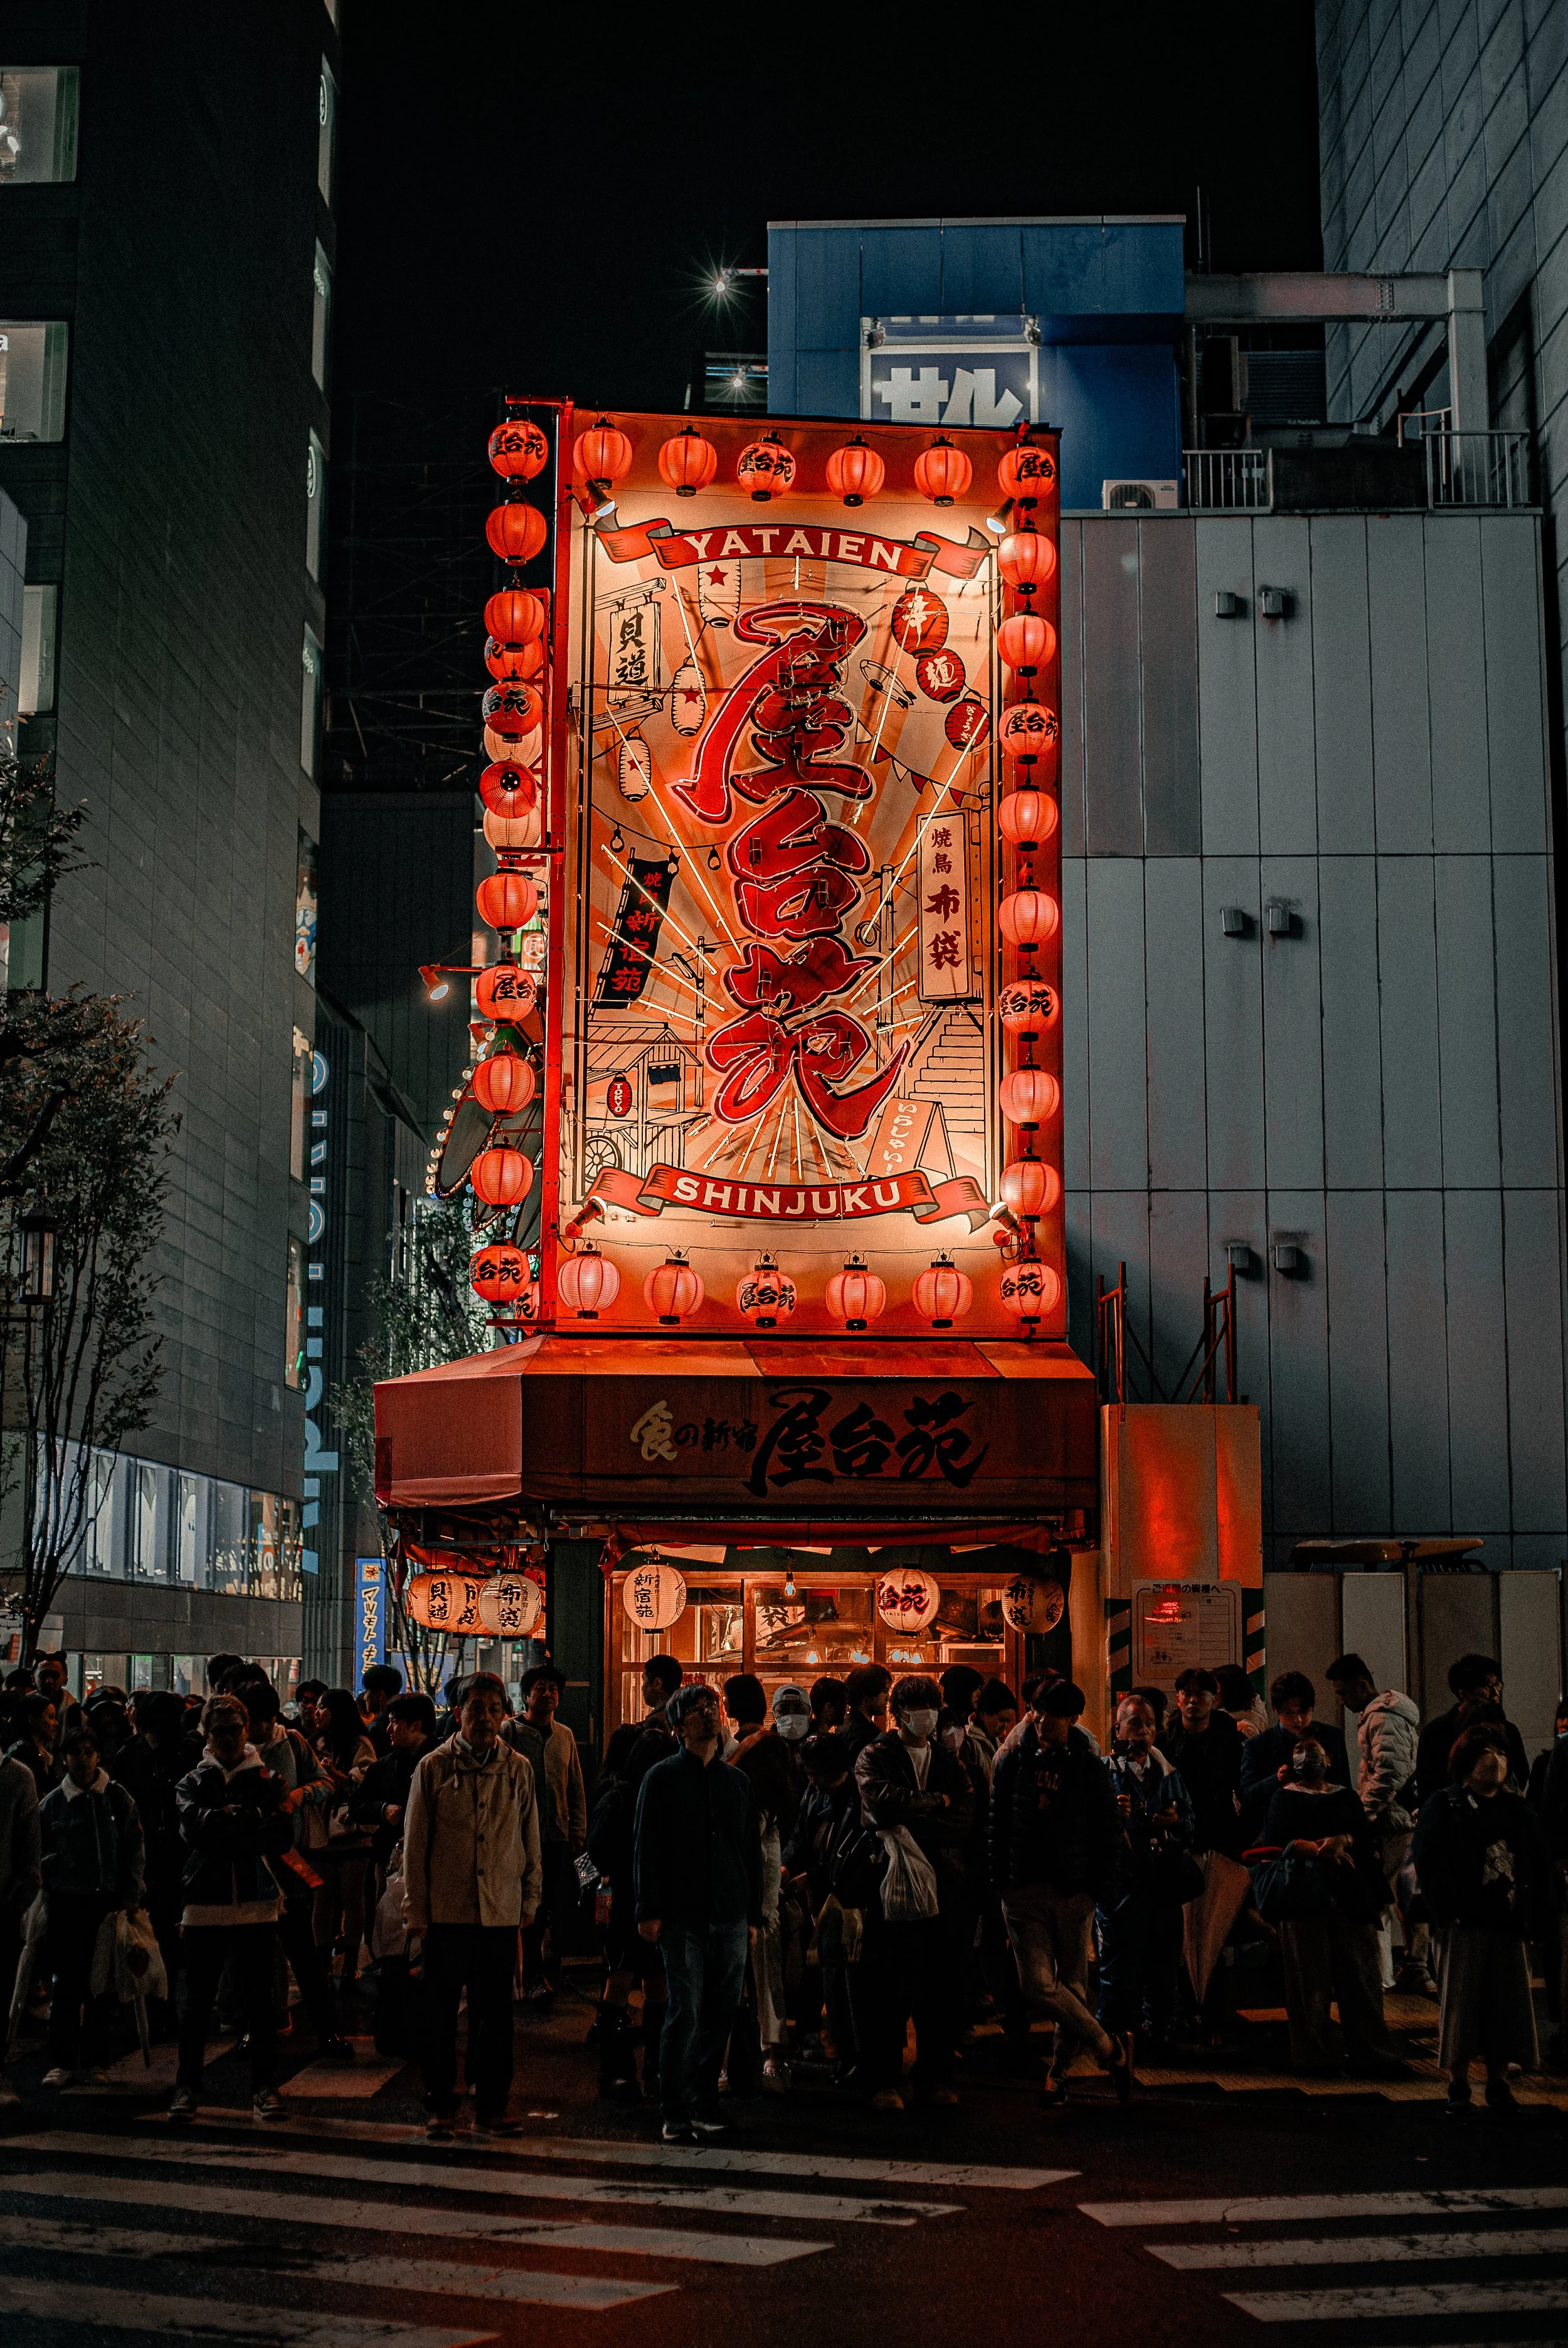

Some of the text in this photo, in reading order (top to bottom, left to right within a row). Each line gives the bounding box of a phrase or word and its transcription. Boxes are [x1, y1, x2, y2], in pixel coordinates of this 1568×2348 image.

[738, 447, 794, 483] 屋台苑
[1014, 452, 1056, 483] 屋台
[684, 529, 903, 571] YATAIEN
[614, 611, 650, 686] 貝道
[924, 655, 958, 692] 麺
[1004, 709, 1057, 743] 屋台苑
[672, 599, 911, 1140] 屋台苑
[923, 827, 965, 970] 焼鳥布袋
[612, 871, 662, 992] 焼肉新宿苑
[490, 974, 536, 1003] 屋台
[614, 1083, 623, 1112] TOKYO
[673, 1177, 901, 1216] SHINJUKU
[739, 1282, 796, 1313] 屋台苑
[1000, 1272, 1046, 1300] 台苑
[740, 1386, 991, 1498] 屋台苑
[428, 1581, 450, 1620] 貝道
[494, 1583, 522, 1627] 布袋
[633, 1573, 654, 1618] 新宿苑
[1005, 1580, 1032, 1627] 布袋
